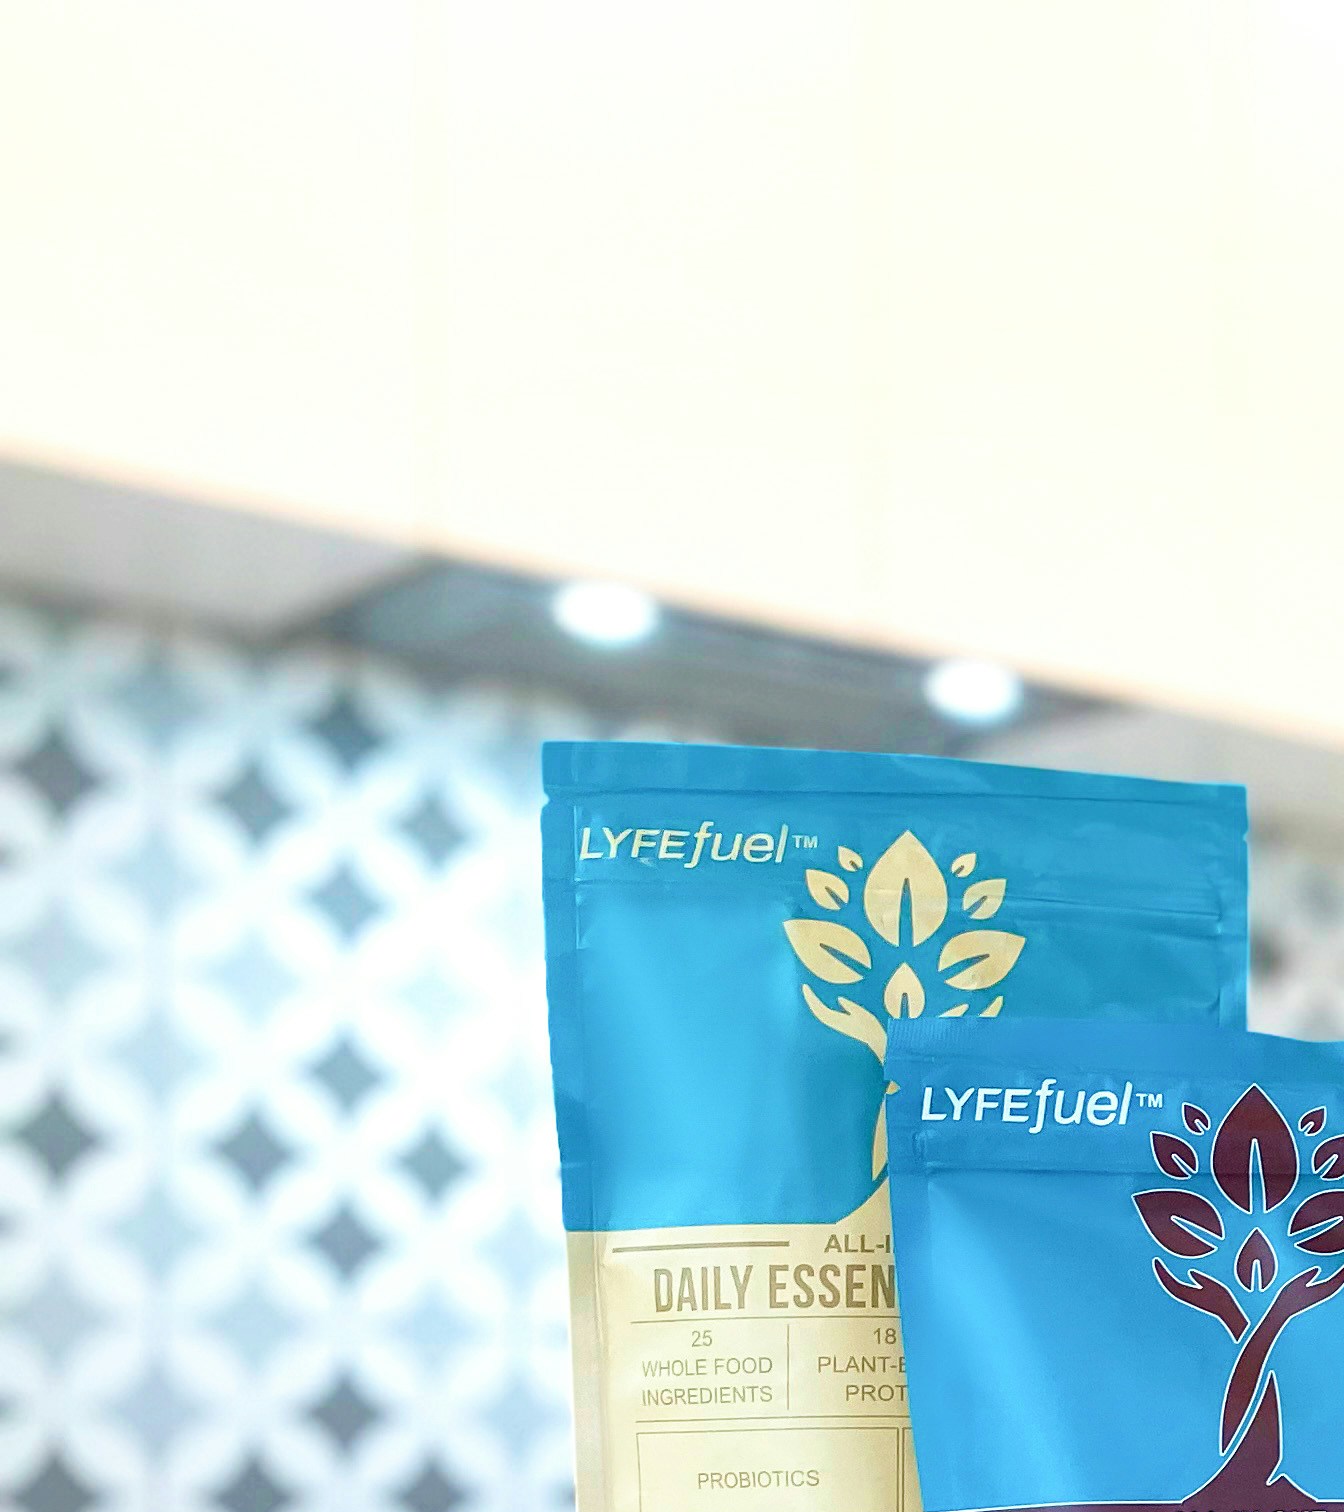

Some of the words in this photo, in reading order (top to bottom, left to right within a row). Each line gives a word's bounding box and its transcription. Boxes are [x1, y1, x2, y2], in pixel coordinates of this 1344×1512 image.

[654, 1265, 753, 1312] DAILY
[692, 1330, 712, 1347] 25
[643, 1359, 707, 1377] WHOLE
[715, 1357, 772, 1375] FOOD
[643, 1386, 772, 1406] INGREDIENTS
[698, 1470, 819, 1489] PROBIOTICS
